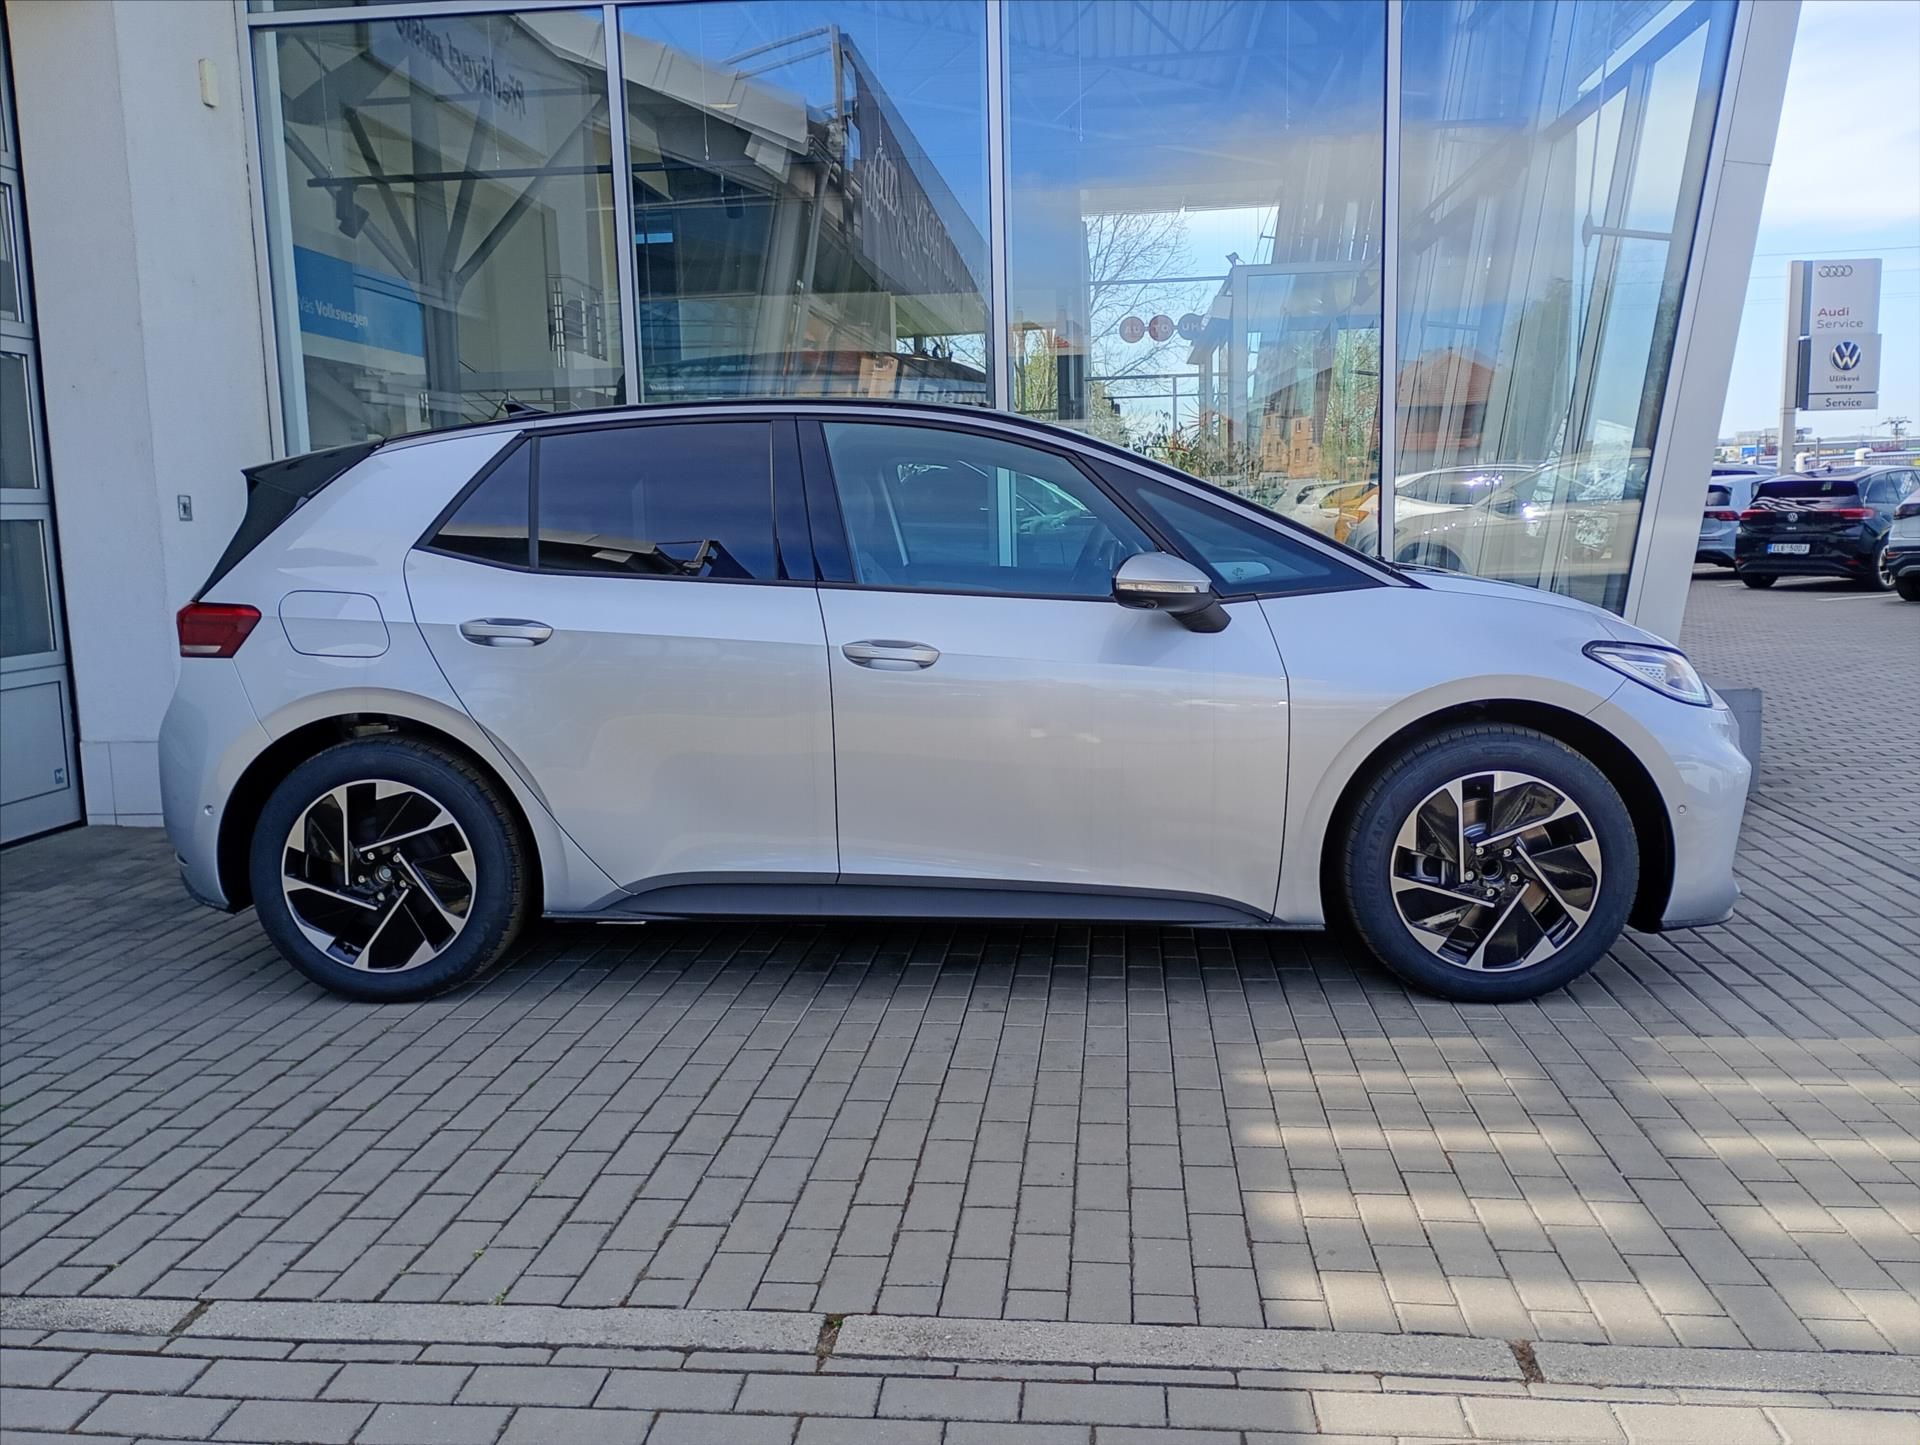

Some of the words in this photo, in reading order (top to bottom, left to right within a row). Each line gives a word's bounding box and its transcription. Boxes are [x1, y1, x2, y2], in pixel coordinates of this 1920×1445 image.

[315, 300, 369, 328] Volkswagen
[1817, 307, 1850, 317] Audi
[1816, 319, 1864, 329] Service
[1825, 397, 1863, 408] Service
